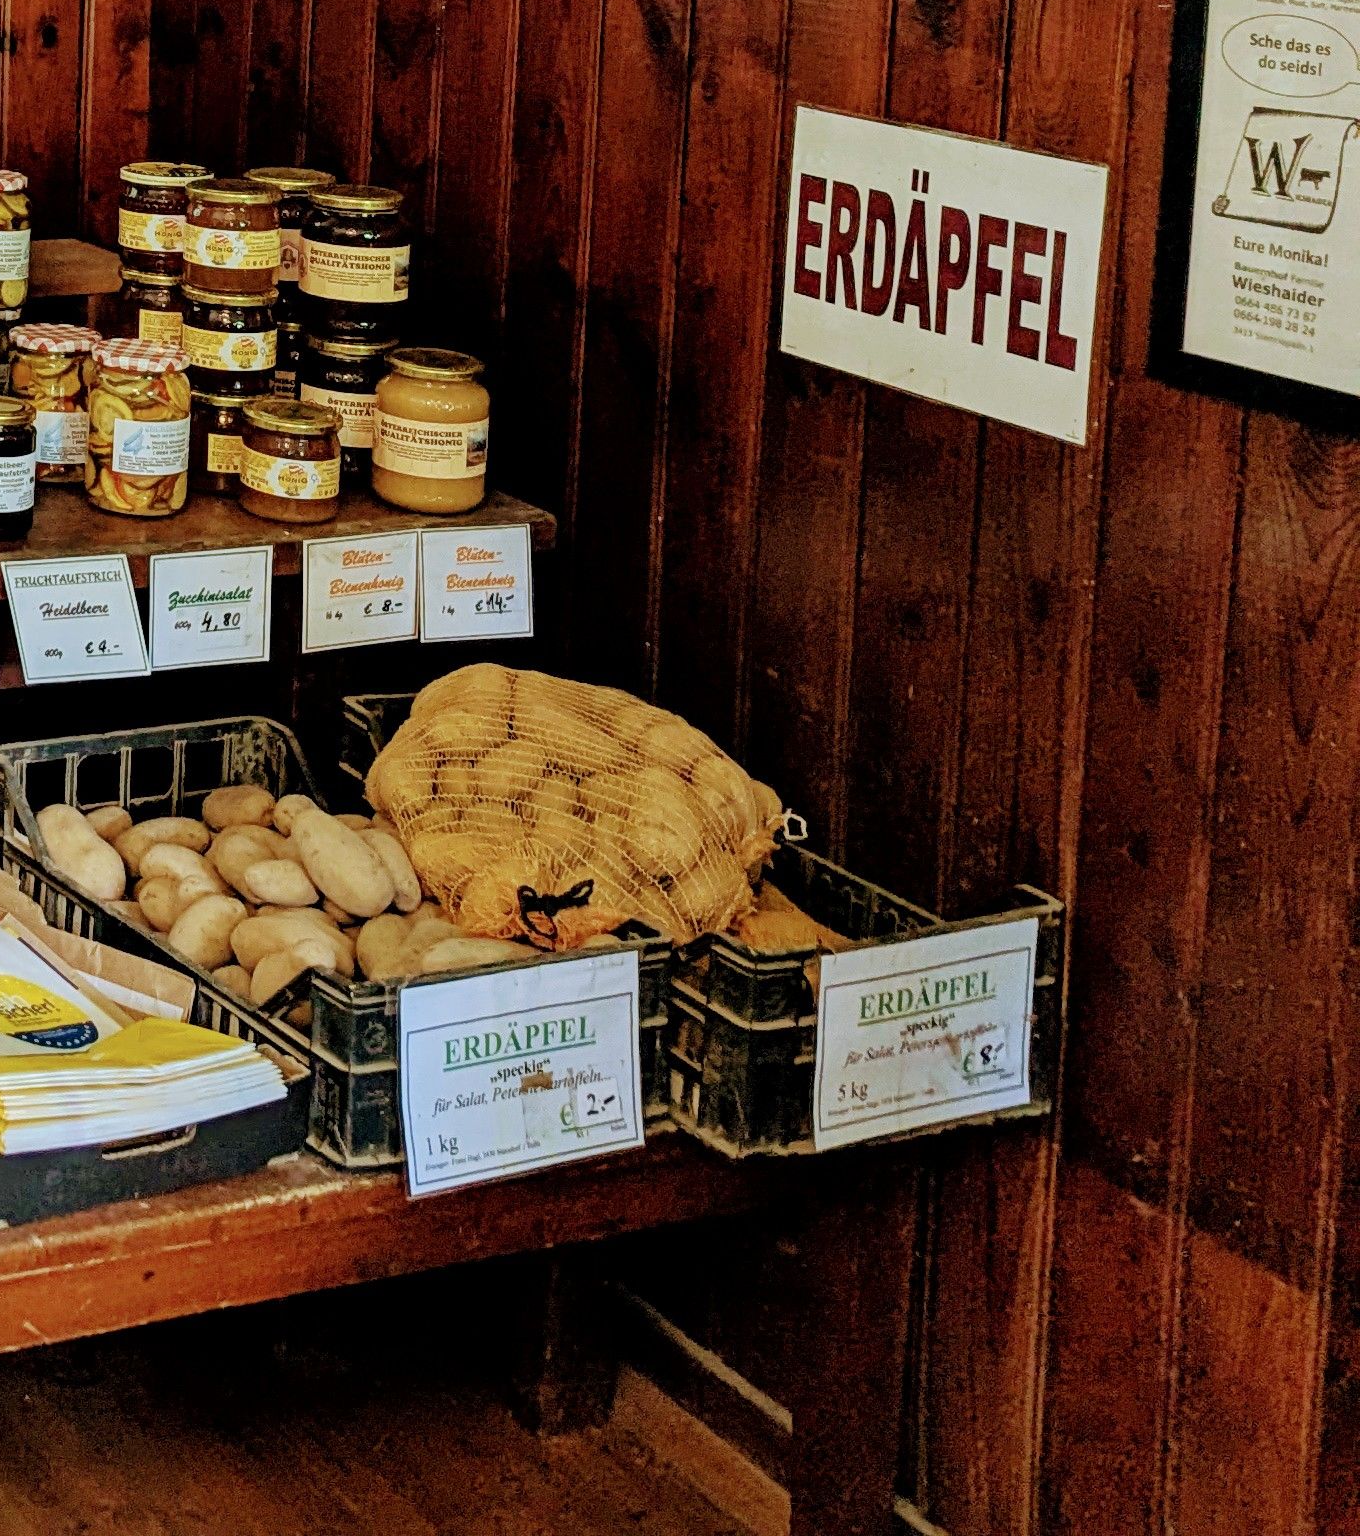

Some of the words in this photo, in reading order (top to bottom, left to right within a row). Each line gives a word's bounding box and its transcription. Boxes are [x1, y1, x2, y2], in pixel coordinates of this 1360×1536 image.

[1249, 33, 1282, 50] Sche
[1286, 38, 1312, 54] das
[1315, 44, 1332, 57] es
[1258, 54, 1277, 70] do
[1280, 59, 1323, 77] seids!
[1233, 236, 1265, 254] Eure
[1268, 243, 1329, 267] Monika!
[793, 168, 1078, 373] ERDÄPFEL
[1232, 274, 1326, 308] Wieshaider
[341, 549, 392, 567] Blüten-
[455, 545, 502, 563] Blüten-
[15, 569, 123, 588] FRUCHTAUFSTRICH
[329, 574, 404, 595] Bienenhonig
[446, 571, 516, 591] Bienenhonig
[168, 586, 254, 611] Zucchinisalat
[364, 602, 373, 614] €
[382, 599, 403, 612] 8.-
[475, 598, 483, 611] €
[40, 600, 109, 619] Heidelbeere
[200, 611, 241, 632] 4,80
[85, 641, 94, 654] €
[859, 970, 997, 1020] ERDÄPFEL
[444, 1015, 597, 1066] ERDÄPFEL
[851, 1081, 869, 1102] kg
[432, 1096, 453, 1118] für
[454, 1089, 489, 1110] Salat,
[439, 1134, 459, 1156] kg
